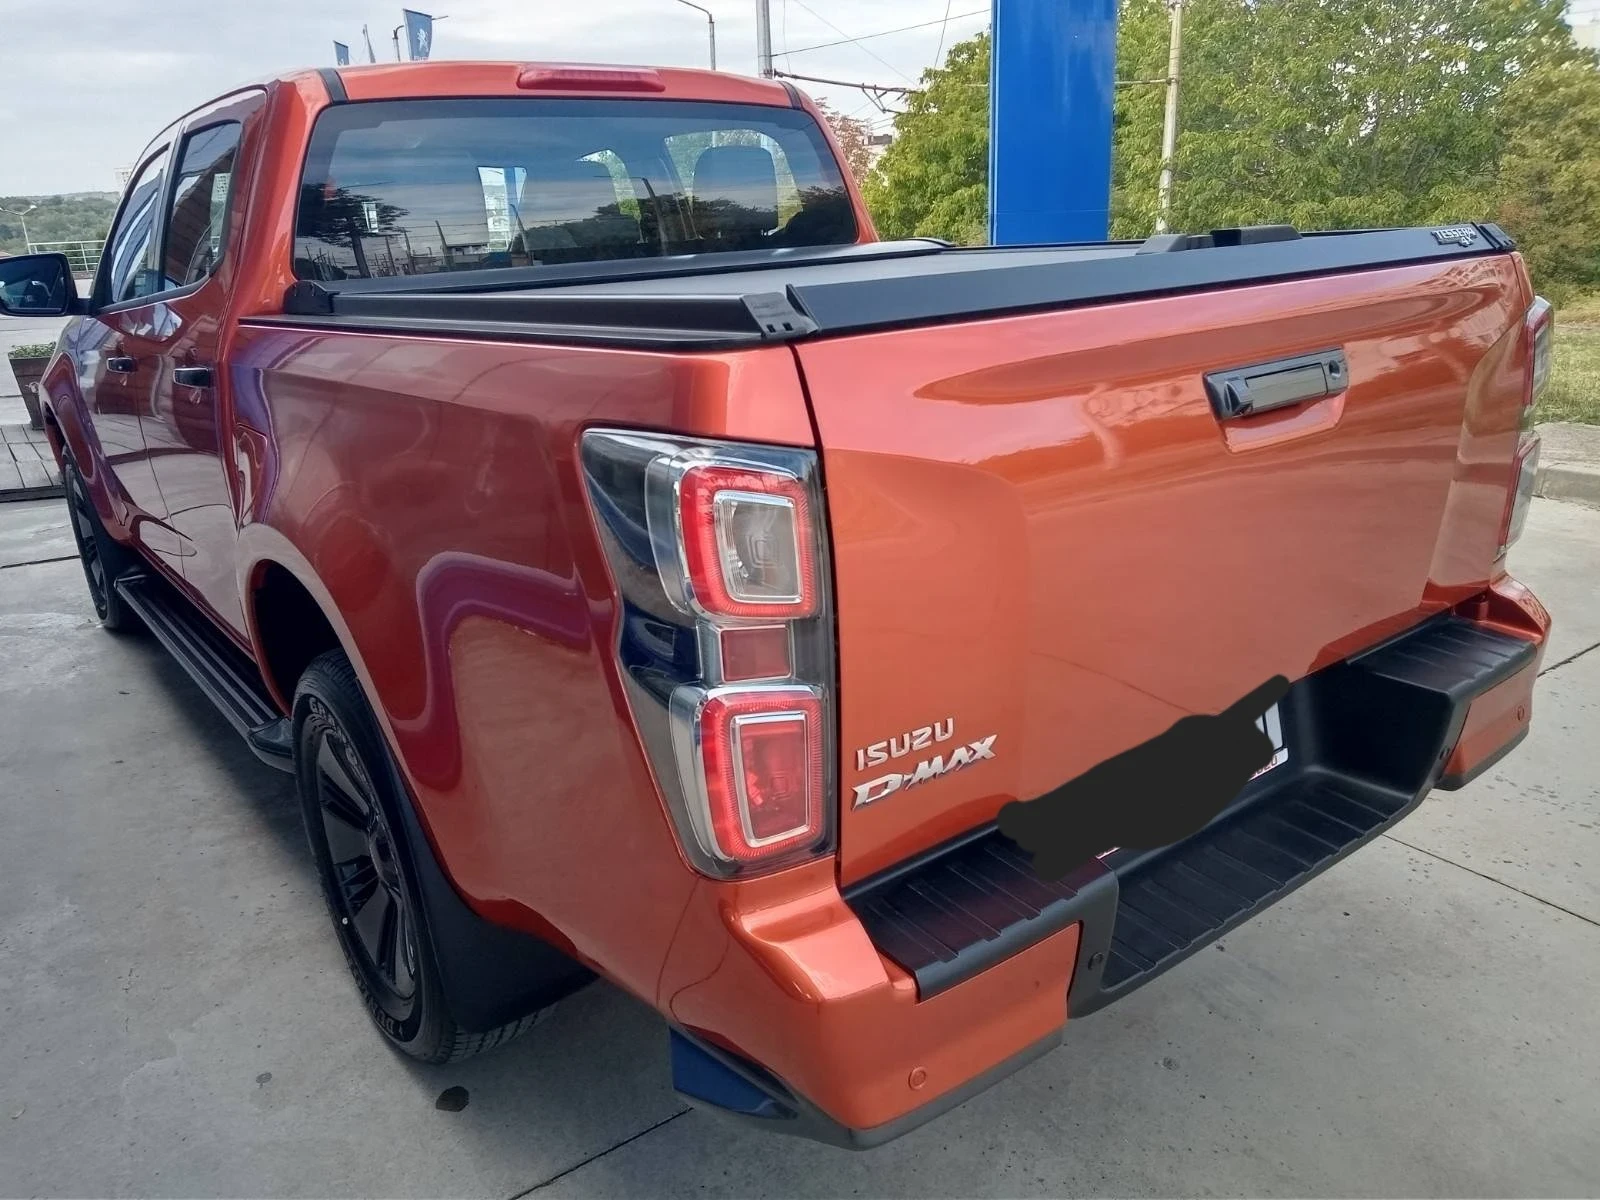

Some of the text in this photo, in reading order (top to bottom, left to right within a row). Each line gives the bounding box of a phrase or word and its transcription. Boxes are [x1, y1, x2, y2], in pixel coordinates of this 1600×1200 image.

[1432, 227, 1476, 239] TESSERA
[856, 717, 954, 772] ISUZU
[851, 734, 998, 811] D-MAX
